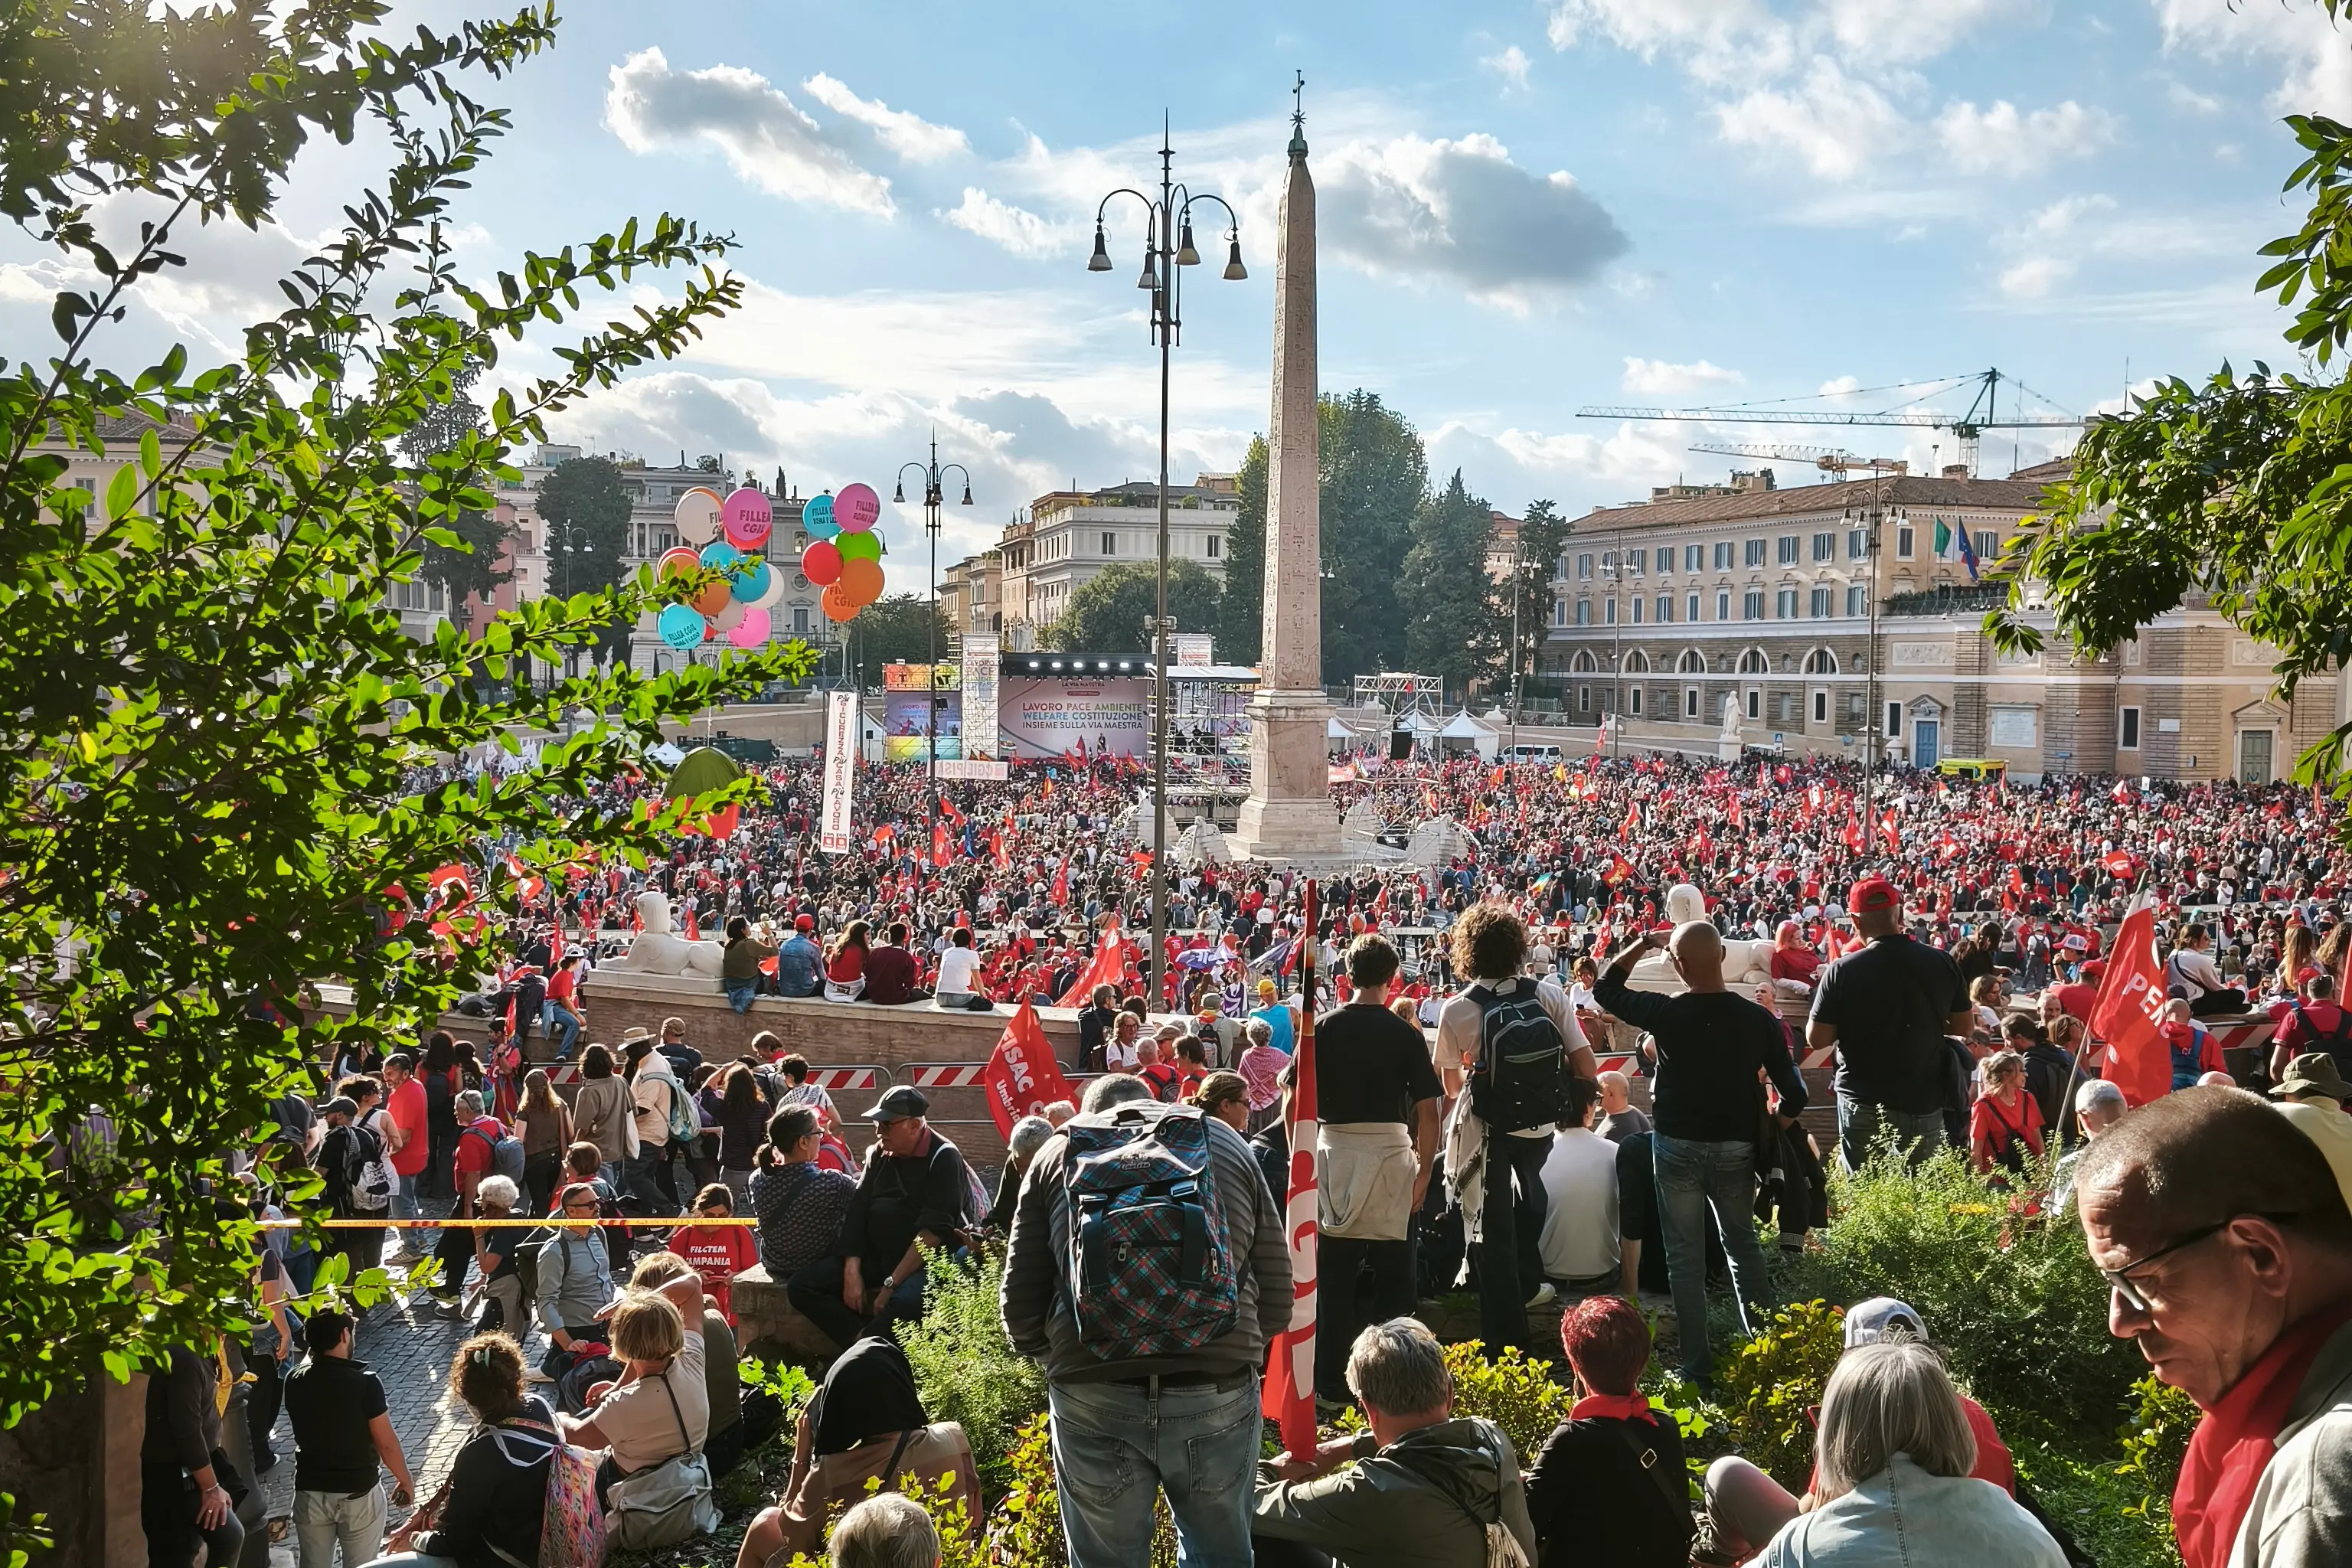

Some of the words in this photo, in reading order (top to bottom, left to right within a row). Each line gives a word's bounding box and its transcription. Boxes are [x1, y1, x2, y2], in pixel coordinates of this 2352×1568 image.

[740, 509, 771, 523] FILLEA
[743, 523, 765, 534] CGIL
[1067, 703, 1090, 711] PACE
[1095, 703, 1142, 711] AMBIENTE
[1024, 712, 1068, 720] WELFARE
[1072, 712, 1142, 720] COSTITUZIONE
[832, 793, 841, 831] LAVORO
[690, 1245, 727, 1254] FILCTEM
